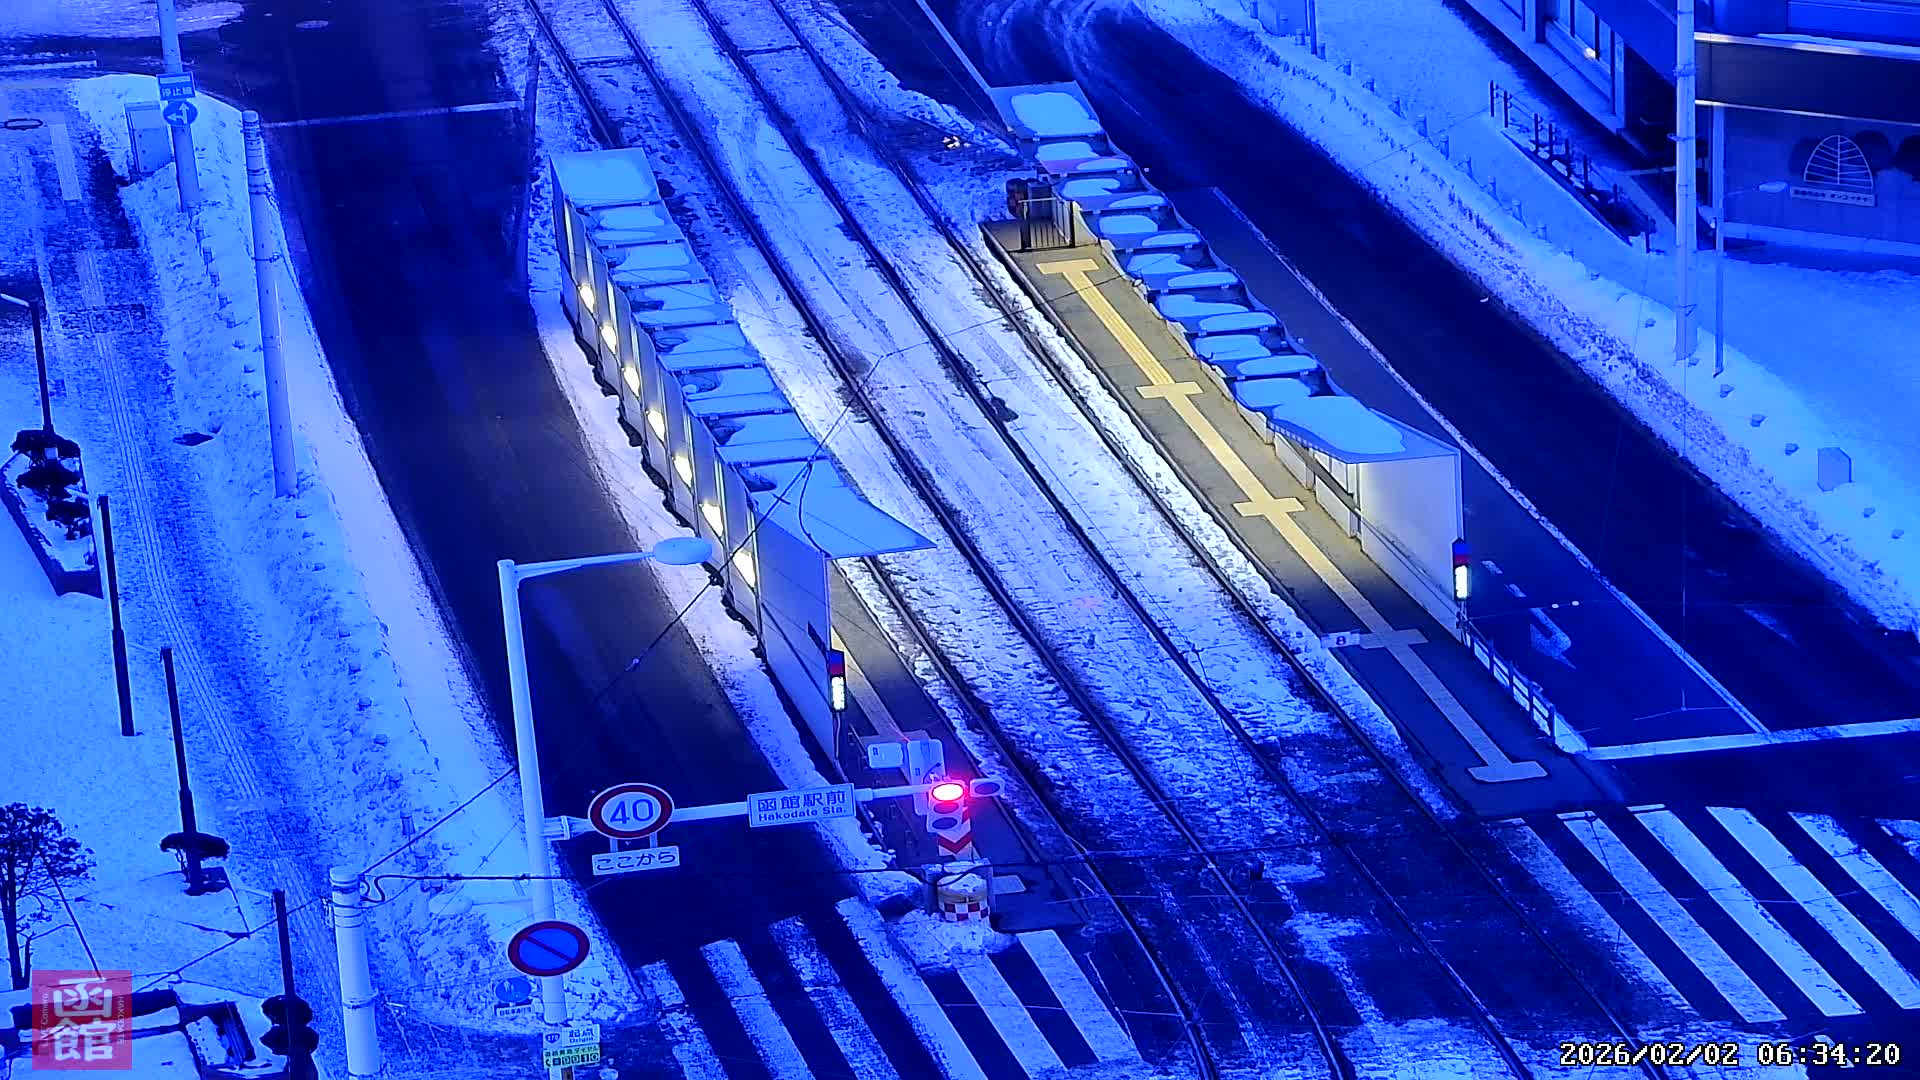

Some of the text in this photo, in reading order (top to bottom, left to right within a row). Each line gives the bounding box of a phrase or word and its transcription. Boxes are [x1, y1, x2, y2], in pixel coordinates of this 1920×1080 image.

[757, 790, 846, 811] 函館駅前
[609, 798, 654, 825] 40
[758, 804, 847, 821] Hakodate Sta.
[596, 852, 676, 871] ここから
[569, 1028, 594, 1038] 起点
